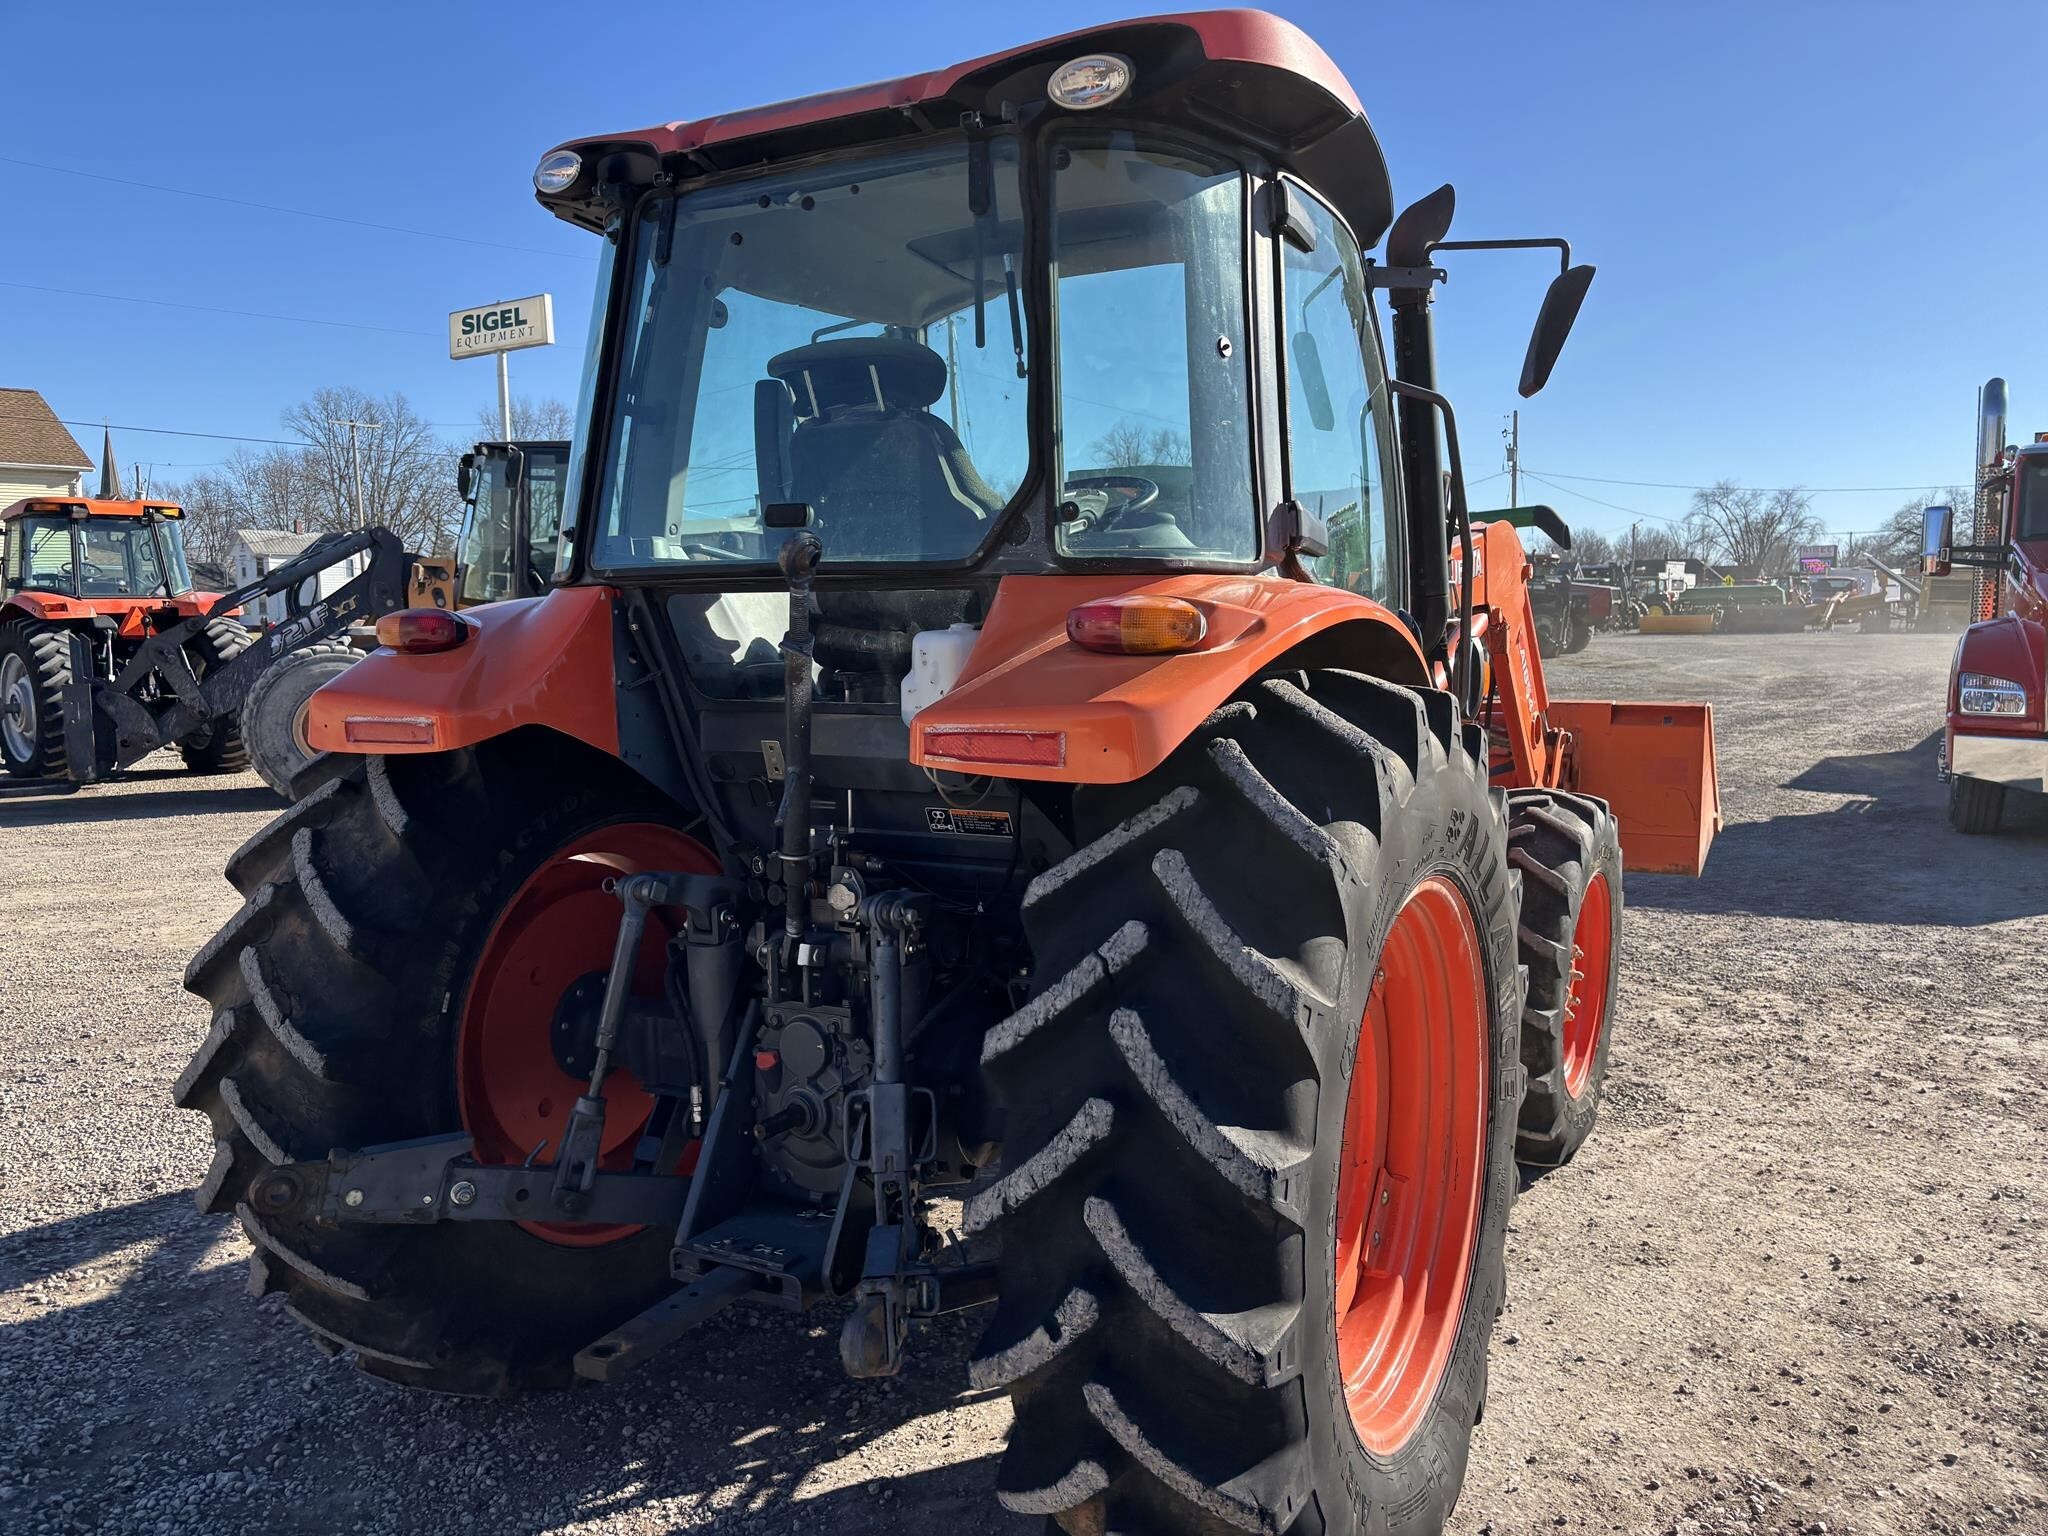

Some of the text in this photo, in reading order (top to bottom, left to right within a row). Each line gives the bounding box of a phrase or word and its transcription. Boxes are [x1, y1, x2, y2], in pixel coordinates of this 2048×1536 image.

[461, 307, 528, 335] SIGEL
[456, 325, 535, 348] EQUIPMENT
[1455, 809, 1519, 1101] ALLIANCE
